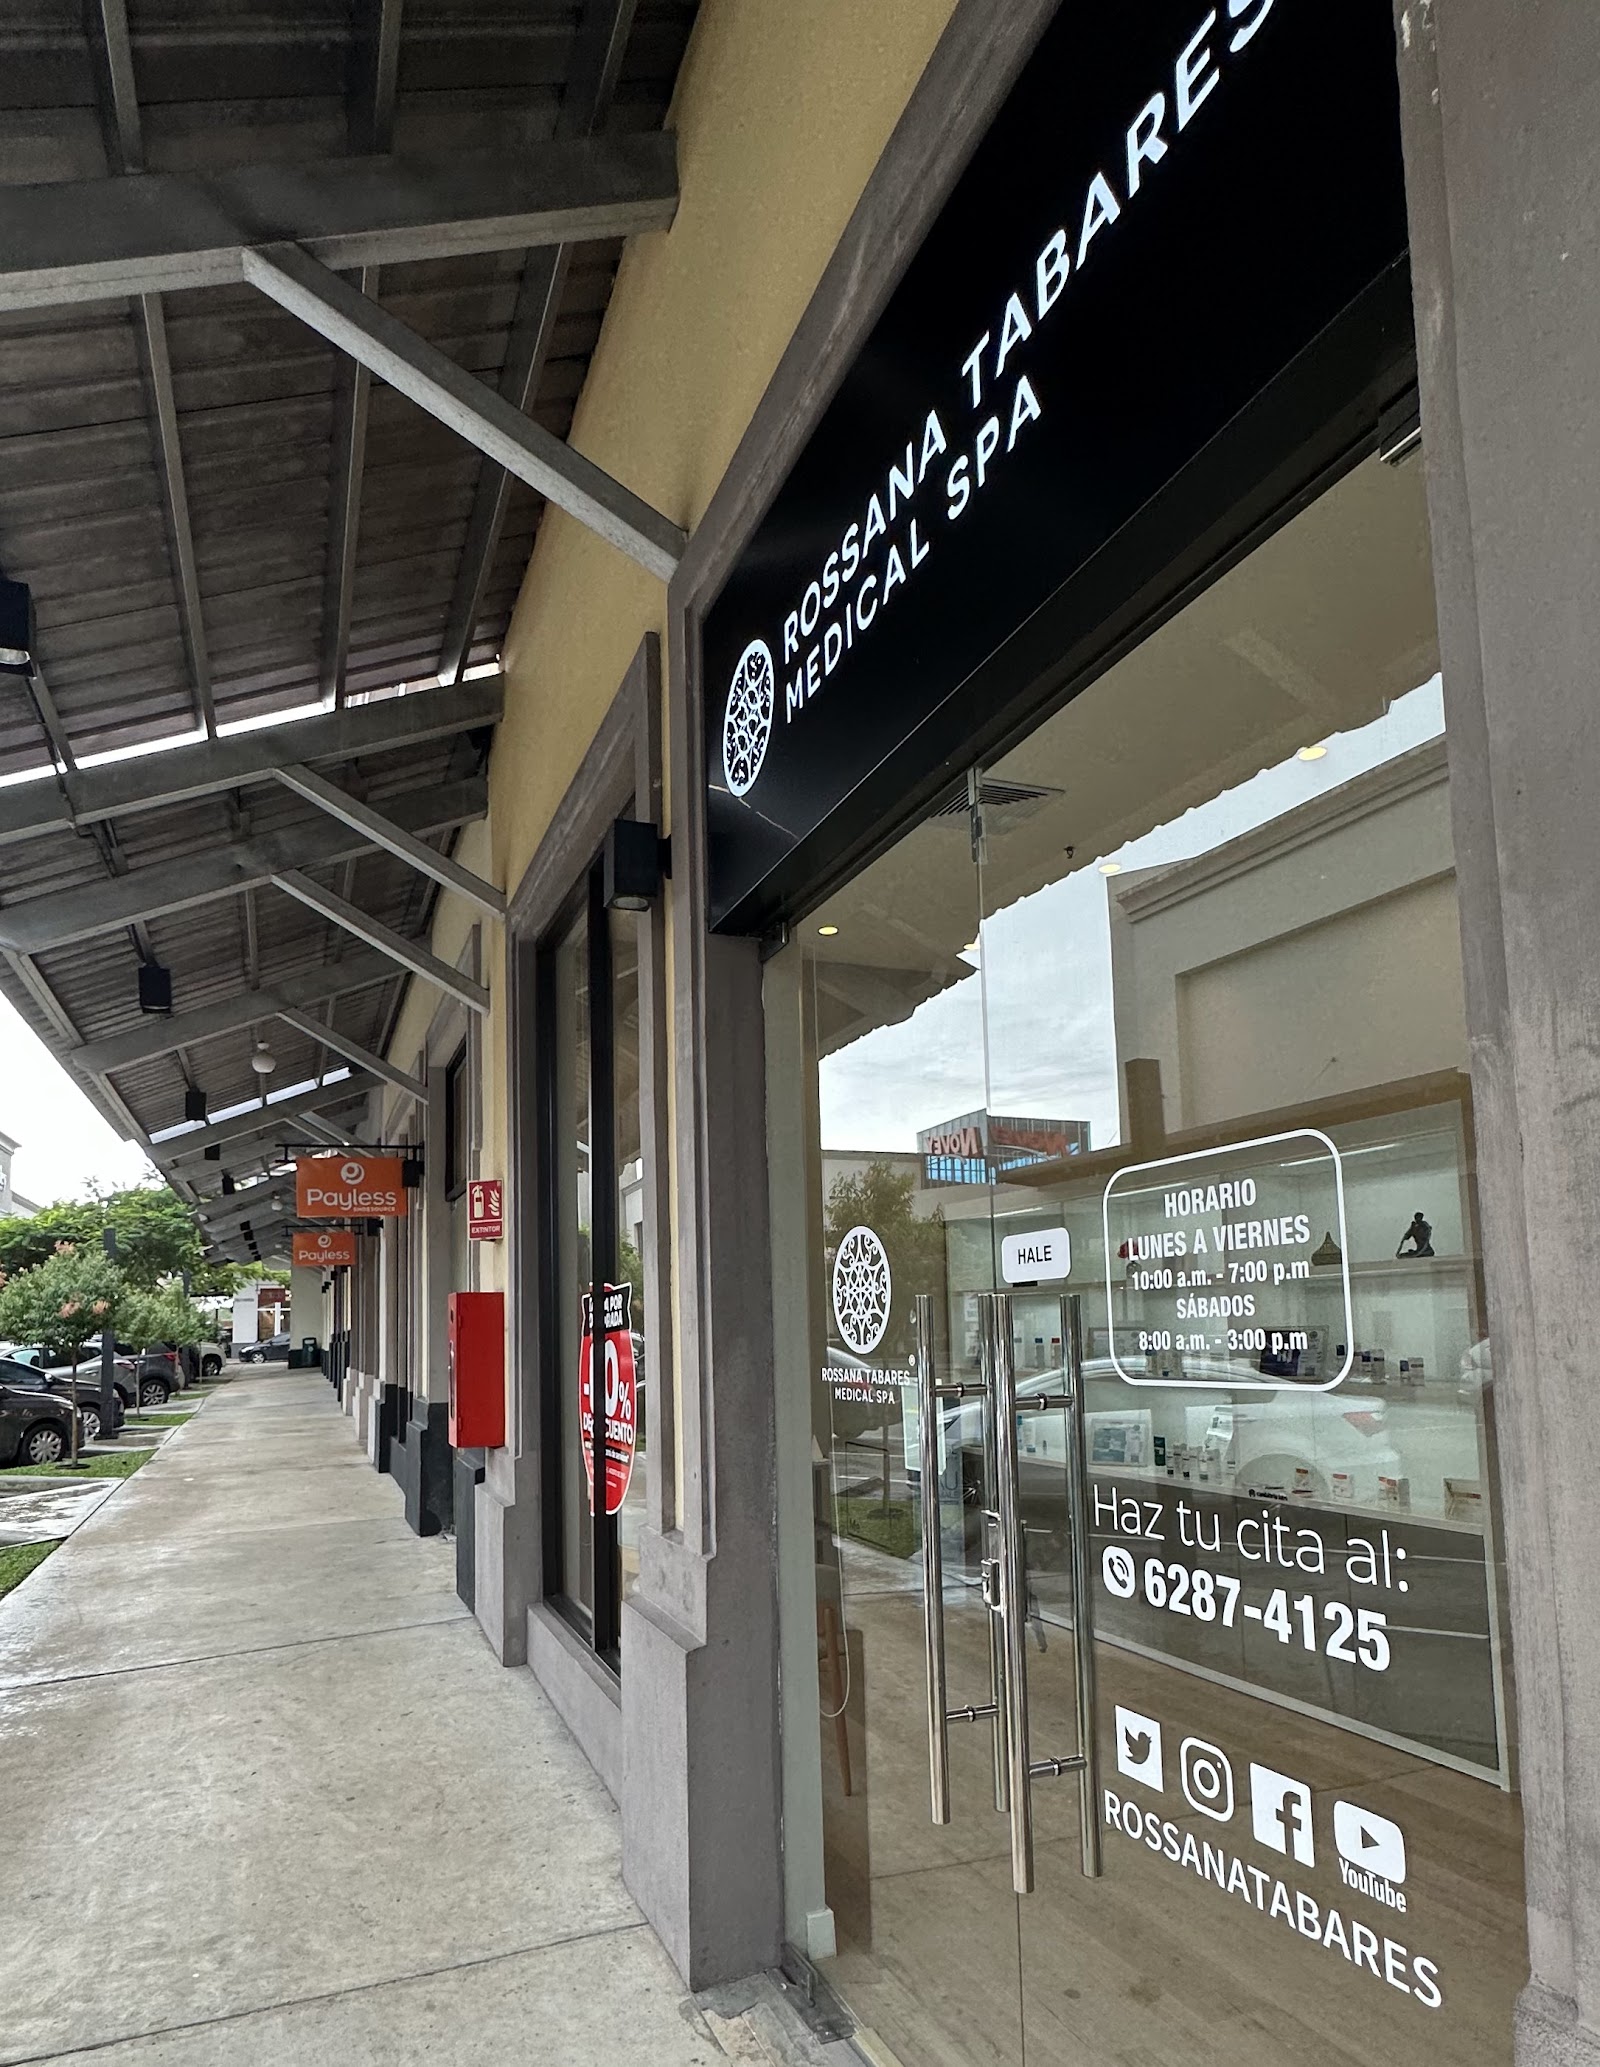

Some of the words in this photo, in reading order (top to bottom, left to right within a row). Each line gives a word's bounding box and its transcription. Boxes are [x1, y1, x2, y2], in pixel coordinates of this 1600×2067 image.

[783, 409, 947, 665] ROSSANA
[961, 0, 1275, 409] TABARES
[785, 518, 930, 724] MEDICAL
[946, 374, 1042, 520] SPA
[306, 1188, 397, 1211] Payless
[1164, 1178, 1256, 1218] HORARIO
[471, 1225, 501, 1234] EXTINTOR
[1127, 1230, 1187, 1261] LUNES
[1193, 1228, 1208, 1255] A
[1213, 1214, 1311, 1252] VIERNES
[298, 1249, 350, 1262] Payless
[1017, 1244, 1052, 1265] HALE
[1131, 1268, 1173, 1291] 10:00
[1176, 1269, 1212, 1288] a.m.
[1228, 1259, 1268, 1284] 7:00
[1273, 1259, 1310, 1286] p.m
[1176, 1293, 1256, 1319] SÁBADOS
[1138, 1331, 1171, 1351] 8:00
[1175, 1334, 1211, 1351] a.m.
[1227, 1328, 1266, 1350] 3:00
[1271, 1331, 1308, 1355] p.m
[583, 1339, 632, 1421] -0%
[821, 1367, 864, 1384] ROSSANA
[865, 1368, 911, 1386] TABARES
[834, 1386, 874, 1403] MEDICAL
[876, 1389, 896, 1405] SPA
[1093, 1484, 1165, 1541] Haz
[1176, 1500, 1221, 1553] tu
[1236, 1509, 1325, 1575] cita
[1346, 1529, 1410, 1593] al:
[1144, 1558, 1391, 1672] 6287-4125
[1103, 1789, 1443, 2009] ROSSANATABARES
[1337, 1856, 1408, 1914] YouTube
